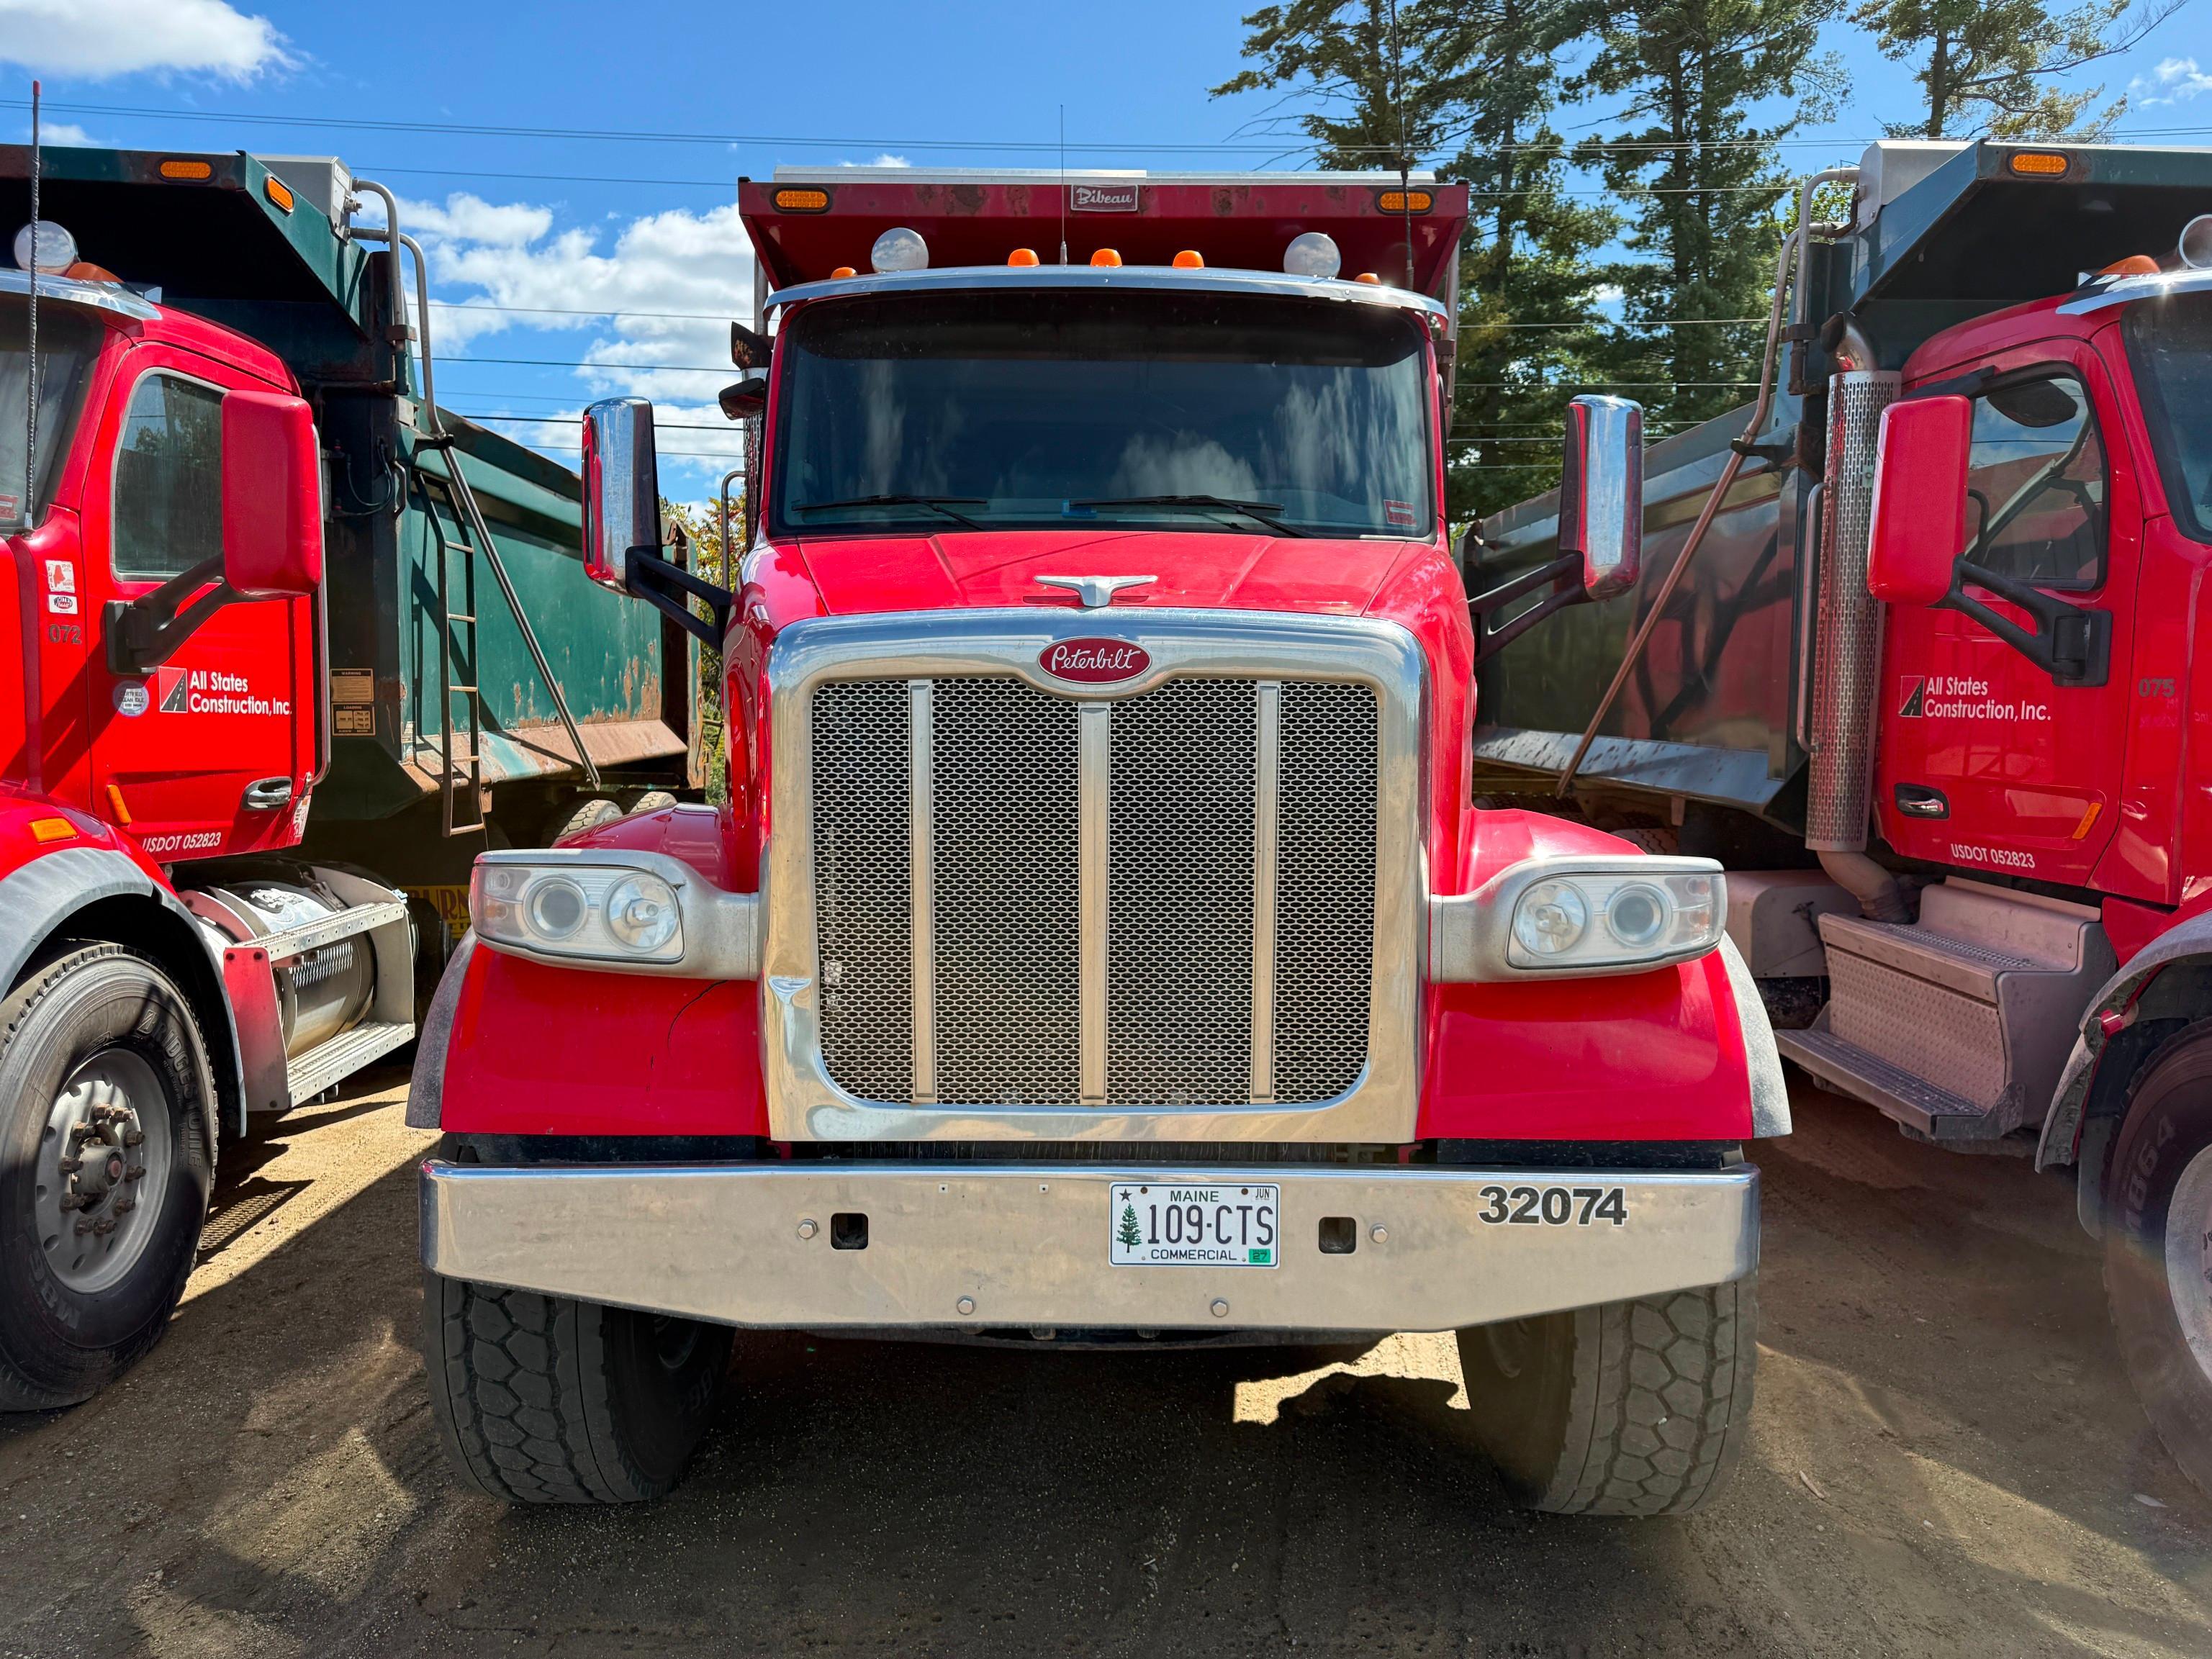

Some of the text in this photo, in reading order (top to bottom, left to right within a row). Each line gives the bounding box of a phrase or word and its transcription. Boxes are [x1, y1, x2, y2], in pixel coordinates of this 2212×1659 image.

[1076, 187, 1132, 204] Bibeau
[48, 623, 82, 645] 072
[1051, 645, 1142, 672] Peterbilt
[189, 670, 248, 692] All States
[1926, 676, 1989, 697] All States
[2138, 678, 2176, 698] 075
[190, 692, 272, 717] Construction,
[1924, 698, 2051, 723] Construction, Inc.
[142, 831, 222, 853] USDOT 052823
[1950, 843, 2036, 869] USDOT 052823
[1170, 1190, 1219, 1203] MAINE
[1255, 1188, 1270, 1198] JUN
[1478, 1184, 1630, 1227] 32074
[1150, 1249, 1237, 1261] COMMERCIAL
[1252, 1252, 1268, 1261] 27
